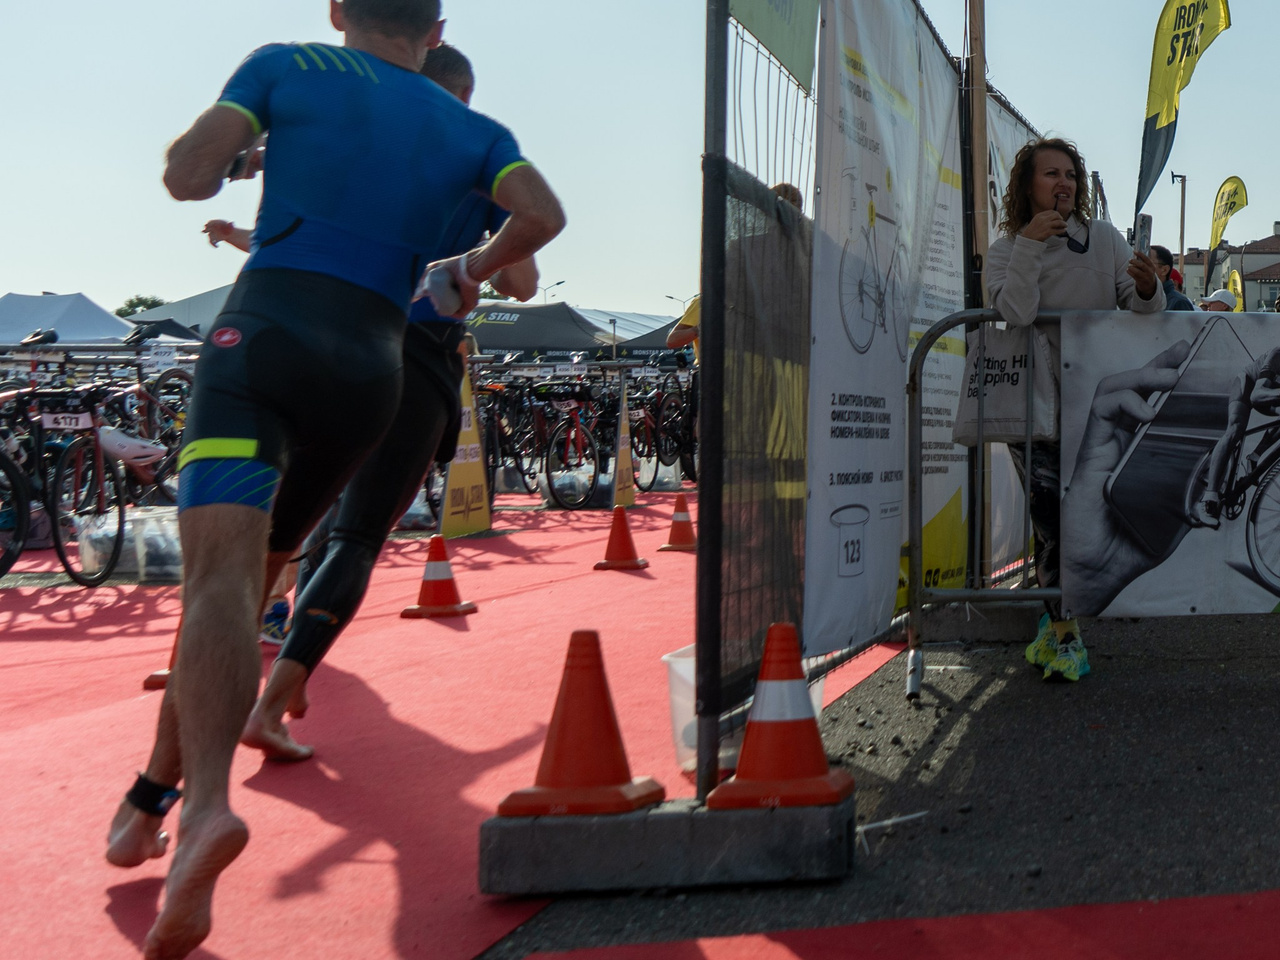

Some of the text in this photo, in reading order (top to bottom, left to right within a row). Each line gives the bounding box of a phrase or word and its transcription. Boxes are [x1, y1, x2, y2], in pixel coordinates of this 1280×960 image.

[1167, 22, 1205, 67] STAR
[488, 312, 520, 321] STAR
[970, 371, 1020, 386] shpping
[831, 393, 838, 406] 2.
[52, 416, 80, 427] 4177
[829, 472, 836, 486] 3.
[836, 468, 861, 486] ПОЯСНОЙ
[844, 538, 861, 564] 123
